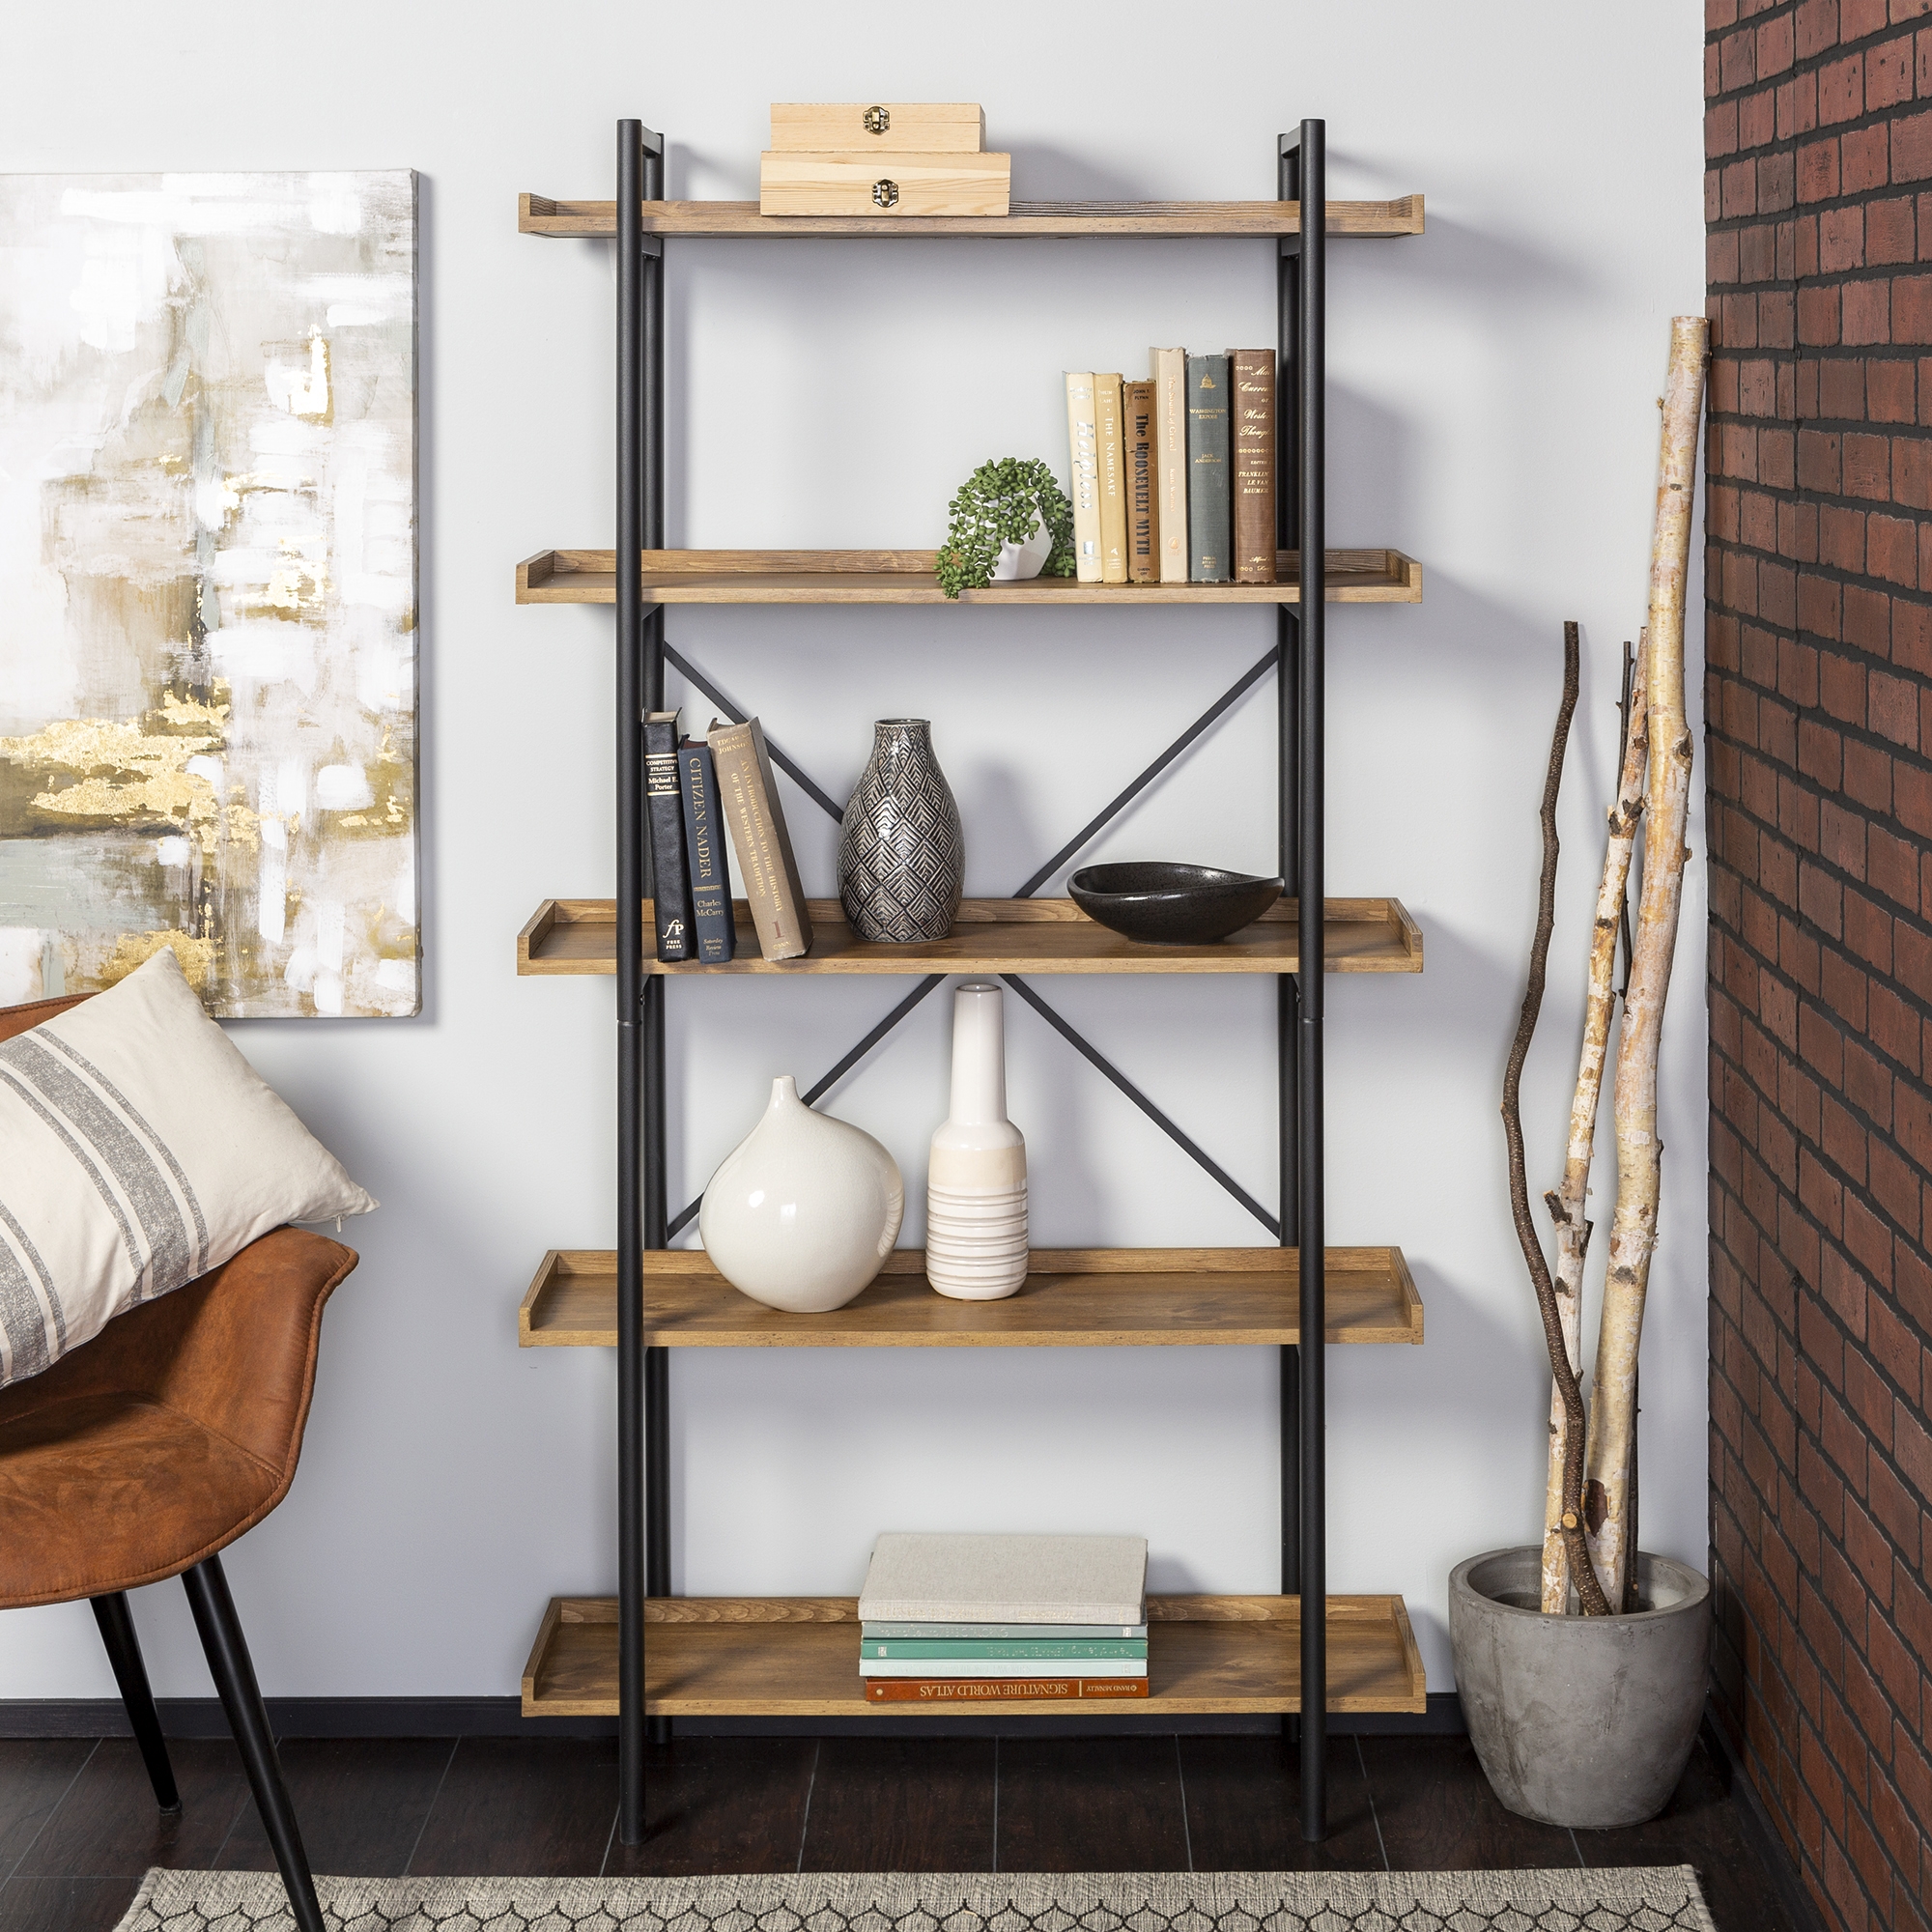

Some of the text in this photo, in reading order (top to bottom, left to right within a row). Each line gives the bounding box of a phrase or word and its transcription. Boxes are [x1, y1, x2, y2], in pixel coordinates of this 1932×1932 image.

[1073, 421, 1096, 510] Helpless
[1104, 416, 1116, 497] THE NAMESAKE
[1134, 413, 1150, 555] The ROOSEVELT MYTH
[719, 741, 750, 754] JOHNSON
[689, 757, 712, 878] CITIZEN NADER
[730, 773, 766, 896] OF THE WESTERN TRADITION
[740, 760, 783, 911] AN INTRODUCTION TO THE HISTORY
[697, 898, 721, 907] Charles
[772, 921, 785, 939] 1
[920, 1683, 1068, 1696] SIGNATURE WORLD ATLAS
